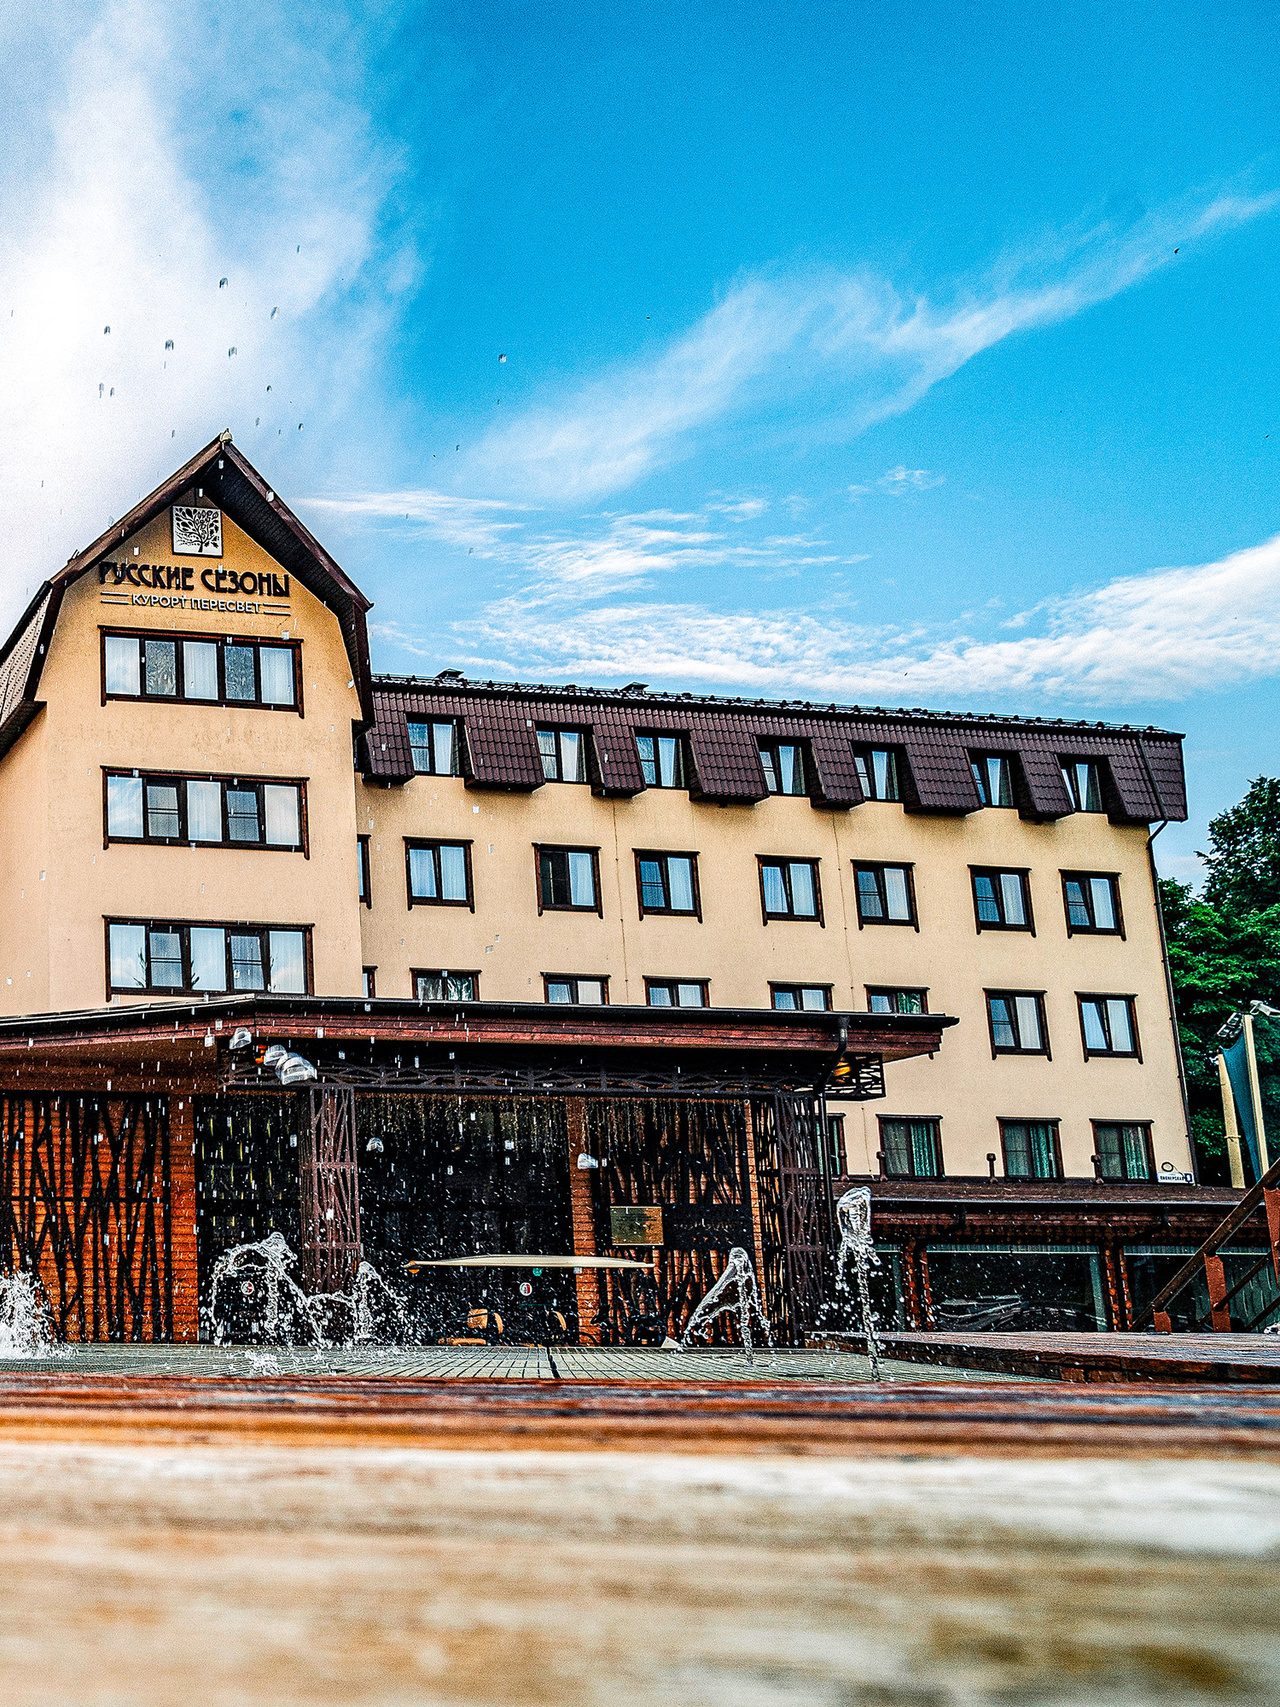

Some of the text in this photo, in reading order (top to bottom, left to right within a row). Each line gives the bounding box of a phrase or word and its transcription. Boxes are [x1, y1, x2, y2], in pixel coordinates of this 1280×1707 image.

[99, 561, 290, 597] РУССКИЕ СЕЗОНЫ
[132, 593, 261, 613] КУРОРТ ПЕРЕСВЕТ
